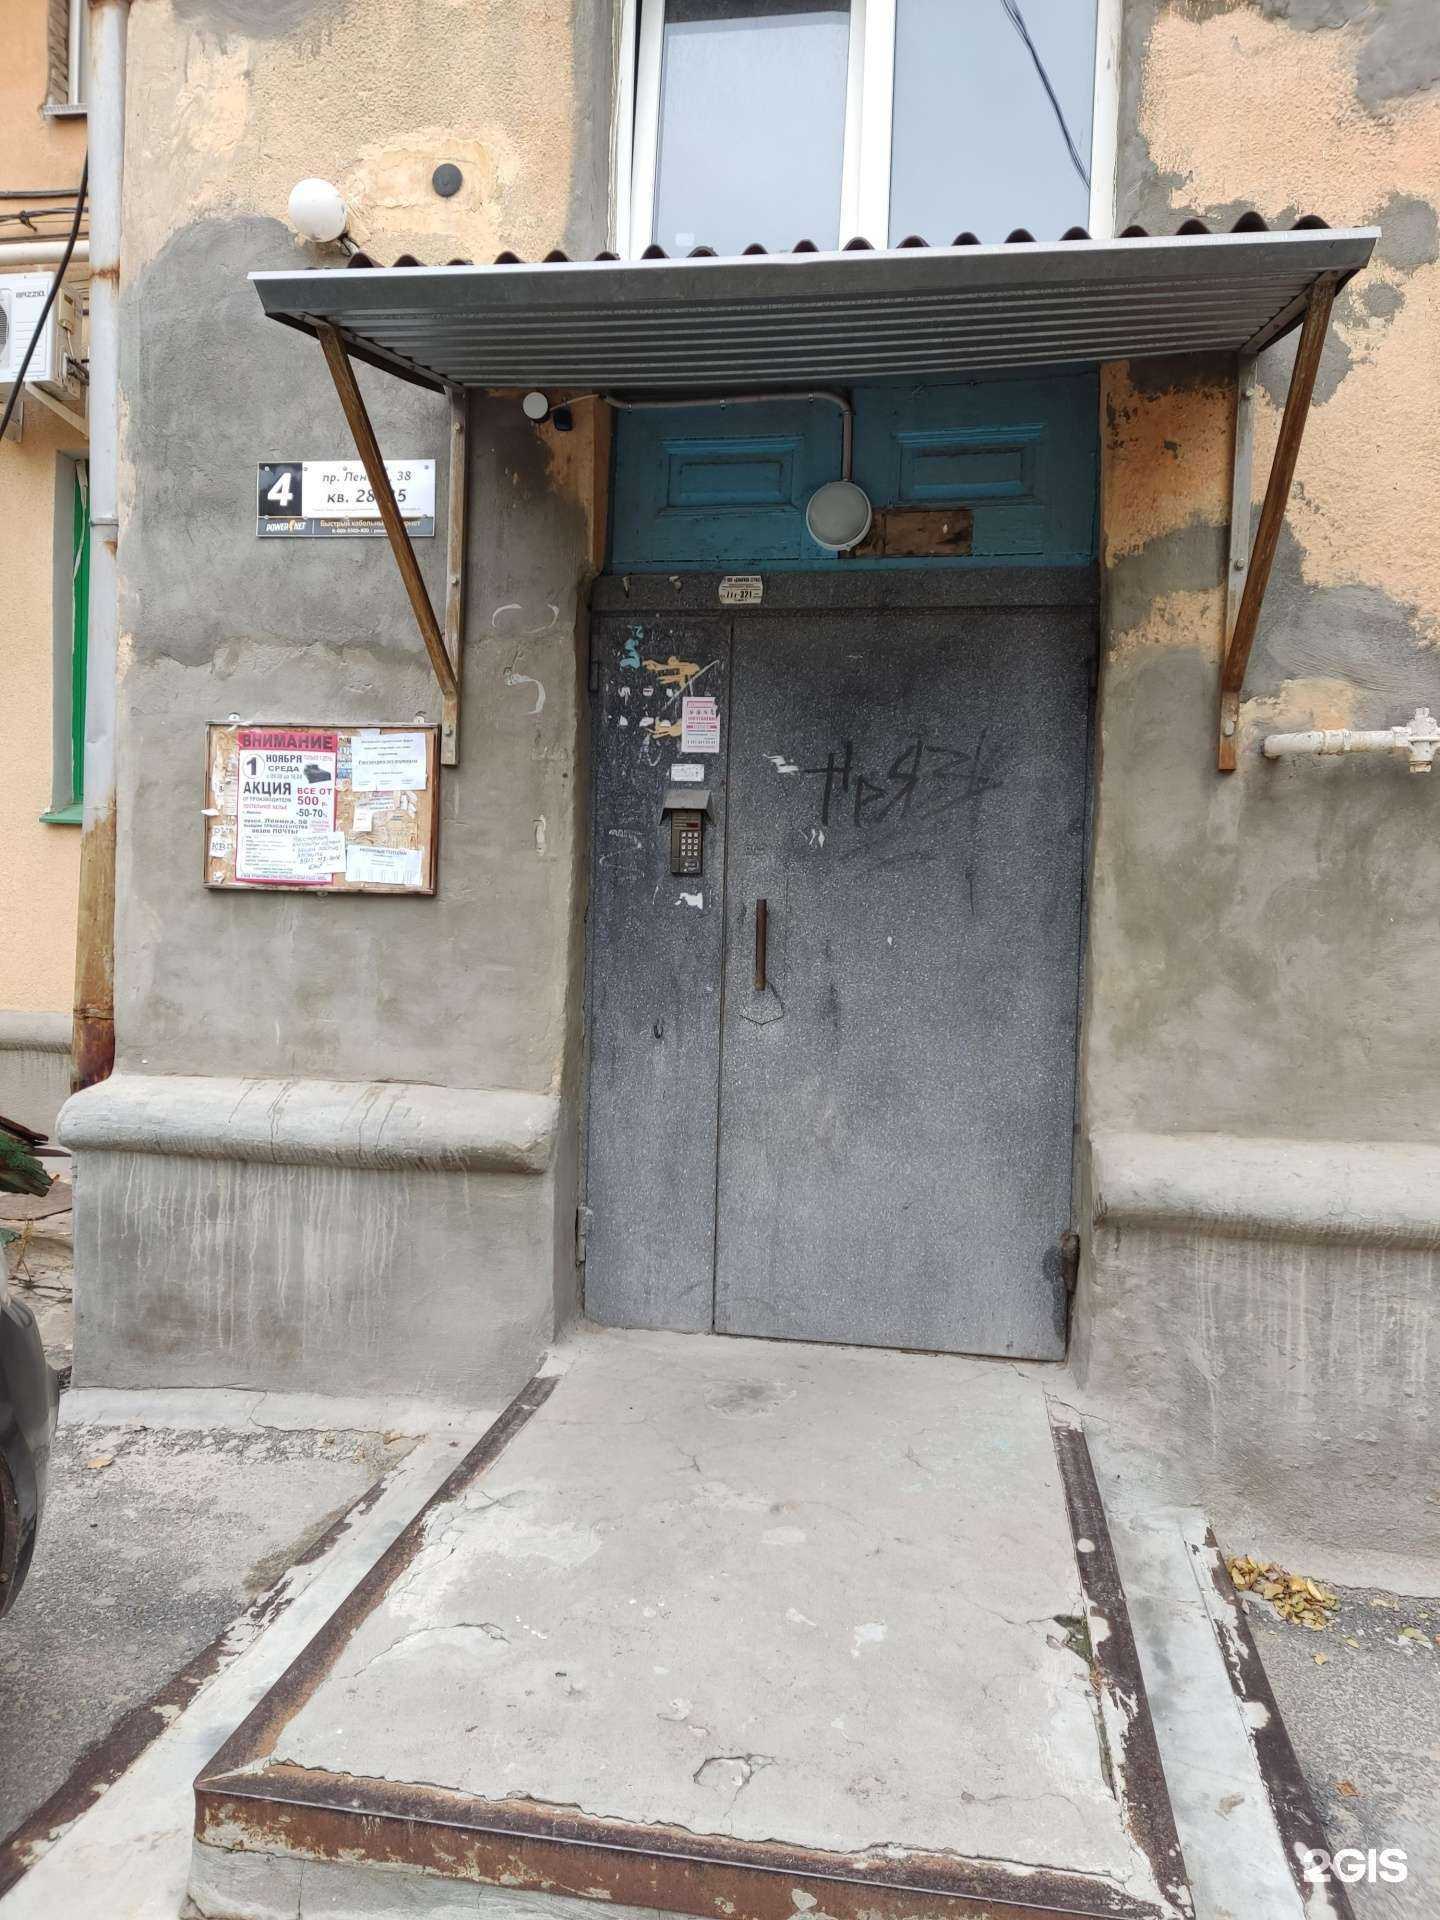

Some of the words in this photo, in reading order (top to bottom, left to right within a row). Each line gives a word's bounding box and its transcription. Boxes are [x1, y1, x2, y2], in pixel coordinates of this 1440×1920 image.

[322, 473, 340, 485] пр.
[344, 471, 392, 483] Лен,
[396, 470, 412, 481] 38
[267, 472, 294, 507] 4
[327, 492, 349, 504] кв.
[320, 519, 350, 529] Быстрый
[242, 734, 333, 750] ВНИМАНИЕ
[266, 754, 302, 764] НОЯБРЯ
[246, 756, 257, 776] 1
[268, 765, 299, 773] СРЕДА
[243, 782, 291, 797] АКЦИЯ
[297, 787, 316, 795] ВСЕ
[319, 787, 333, 796] ОТ
[297, 796, 319, 806] 500
